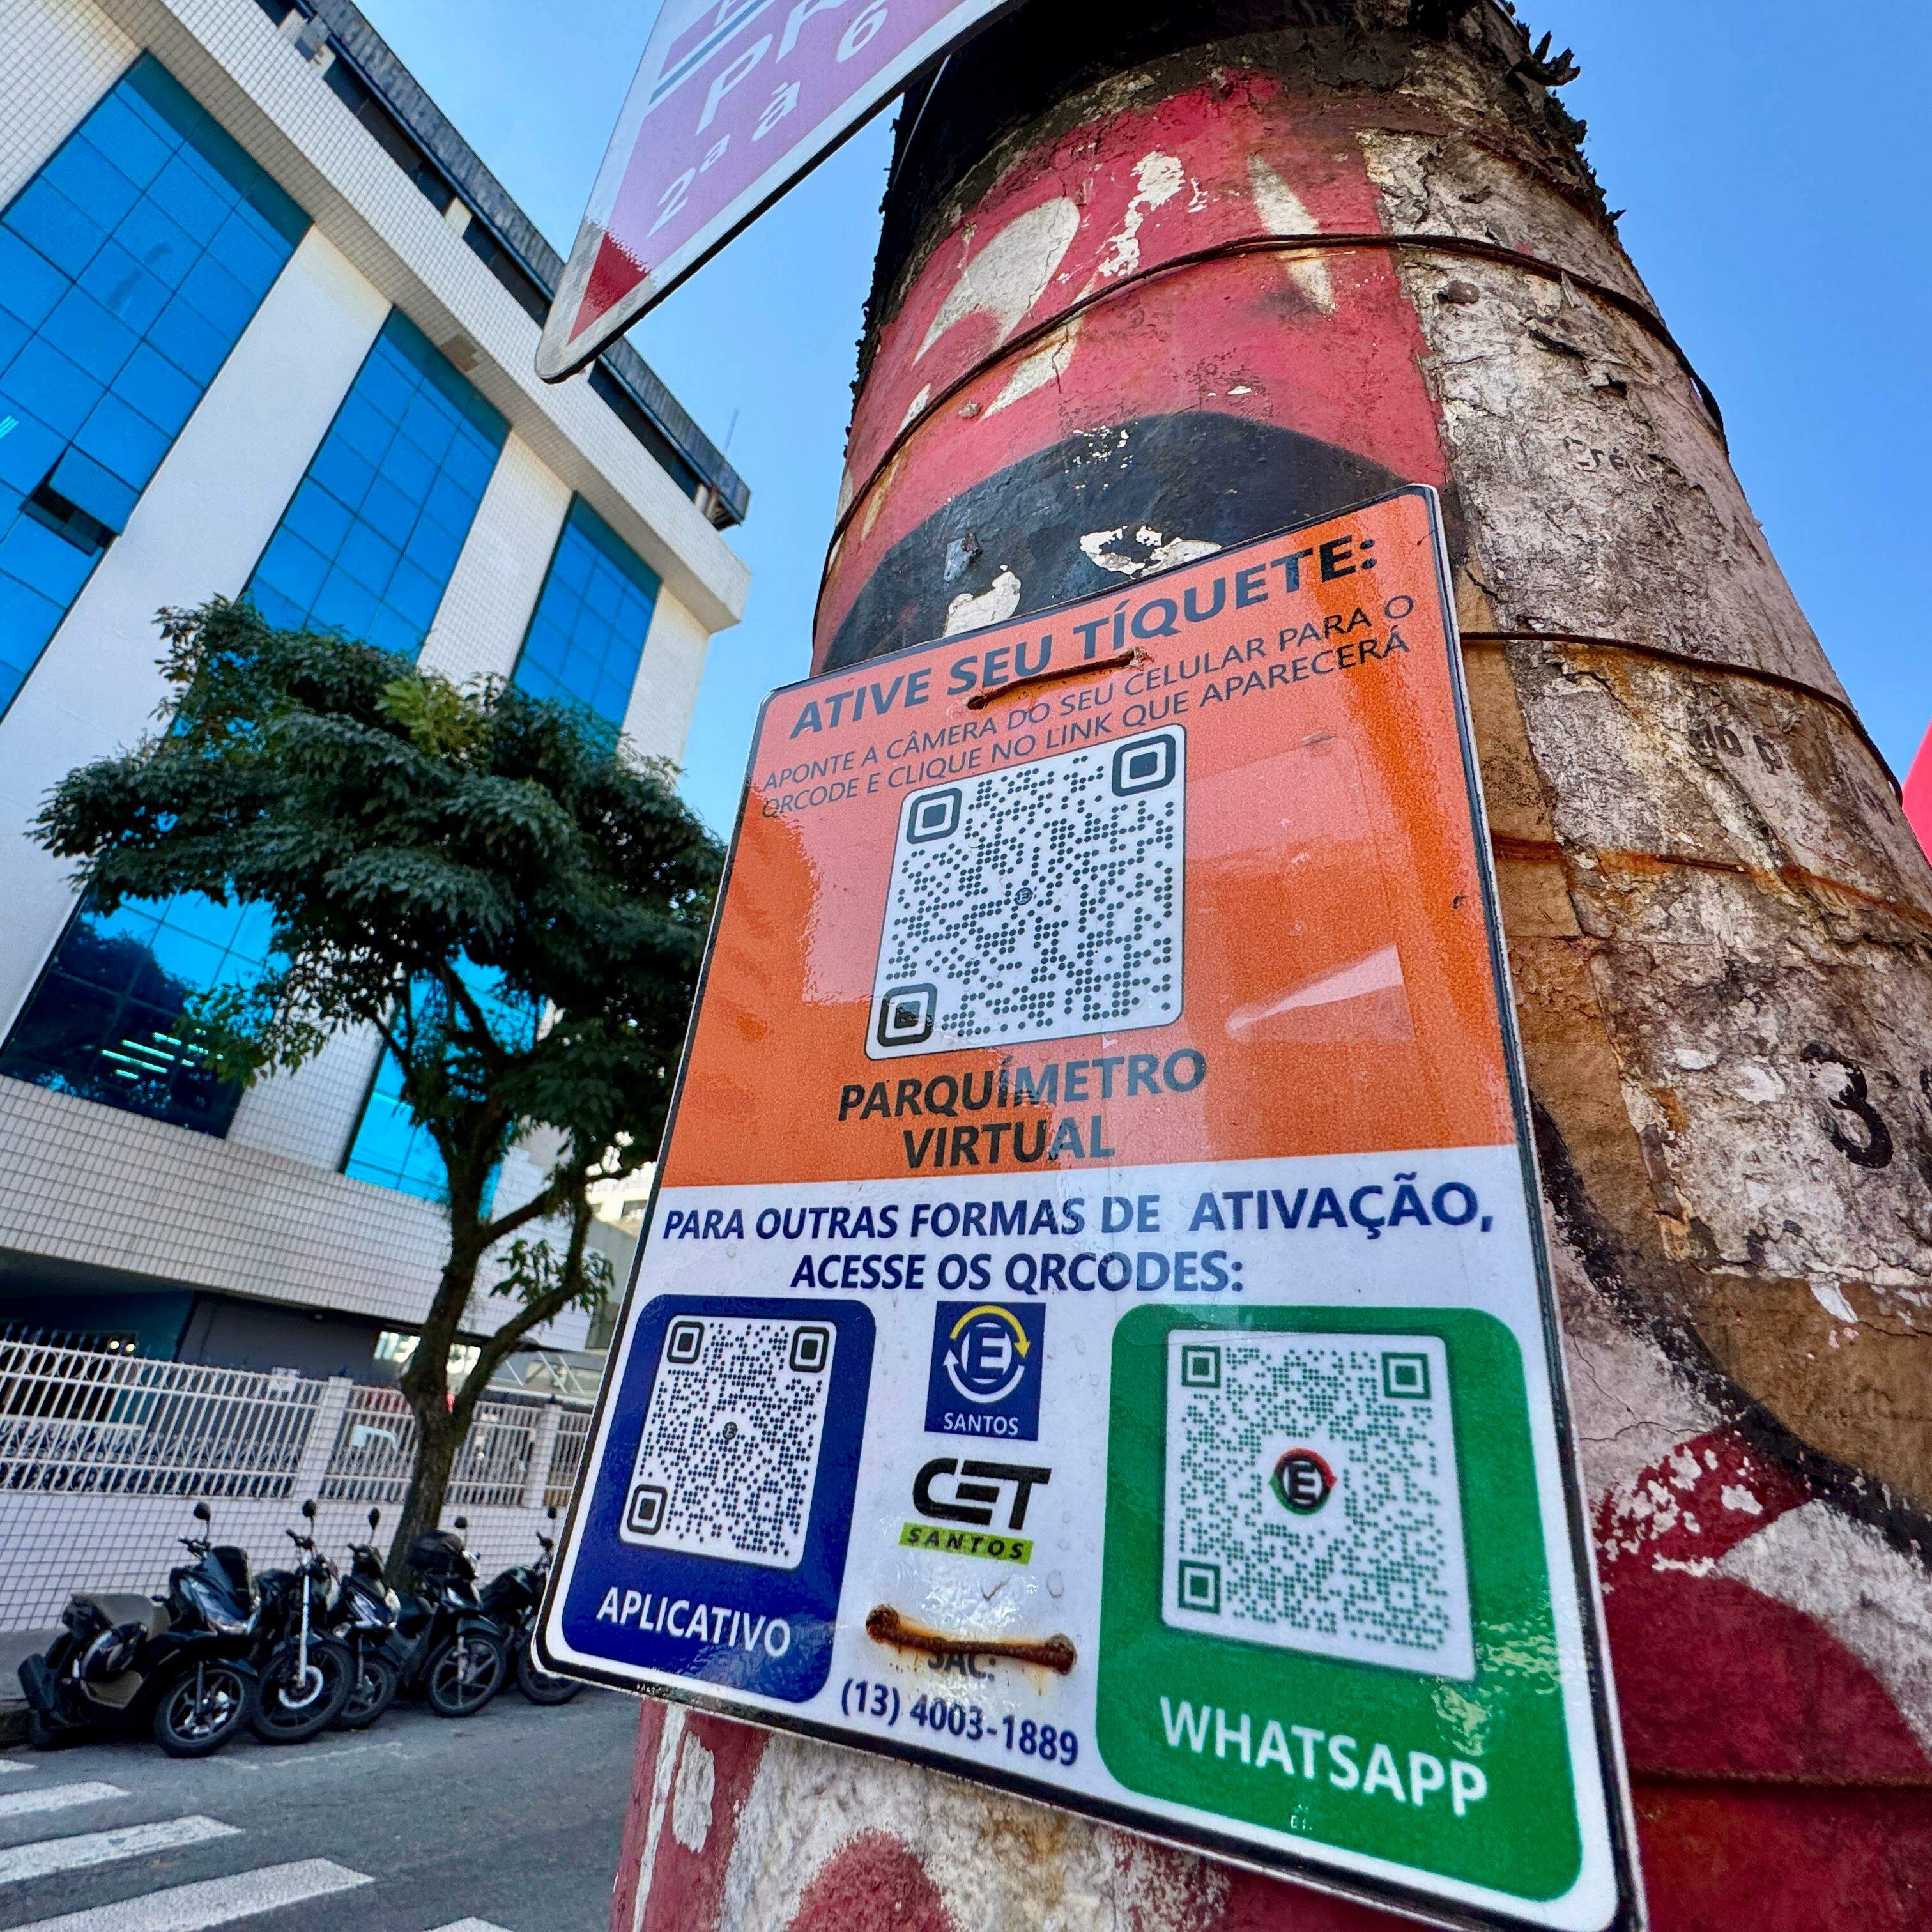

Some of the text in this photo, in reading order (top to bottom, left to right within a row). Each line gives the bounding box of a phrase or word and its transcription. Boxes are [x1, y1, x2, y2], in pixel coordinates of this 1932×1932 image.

[789, 533, 1377, 739] ATIVE SEU TÍQUETE:
[762, 625, 1411, 818] QRCODE E CLIQUE NO LINK QUE APARECERÁ
[763, 594, 1414, 792] APONTE A CÂMERA DO SEU CELULAR PARA O
[838, 1048, 1207, 1121] PARQUÍMETRO
[903, 1115, 1116, 1169] VIRTUAL
[663, 1172, 1494, 1240] PARA OUTRAS FORMAS DE ATIVAÇÃO,
[791, 1250, 1243, 1296] ACESSE OS QRCODES:
[943, 1412, 1020, 1436] SANTOS
[907, 1528, 1025, 1560] SANTOS
[597, 1586, 791, 1657] APLICATIVO
[841, 1678, 1080, 1767] (13) 4003-1889
[1160, 1695, 1487, 1817] WHATSAPP
